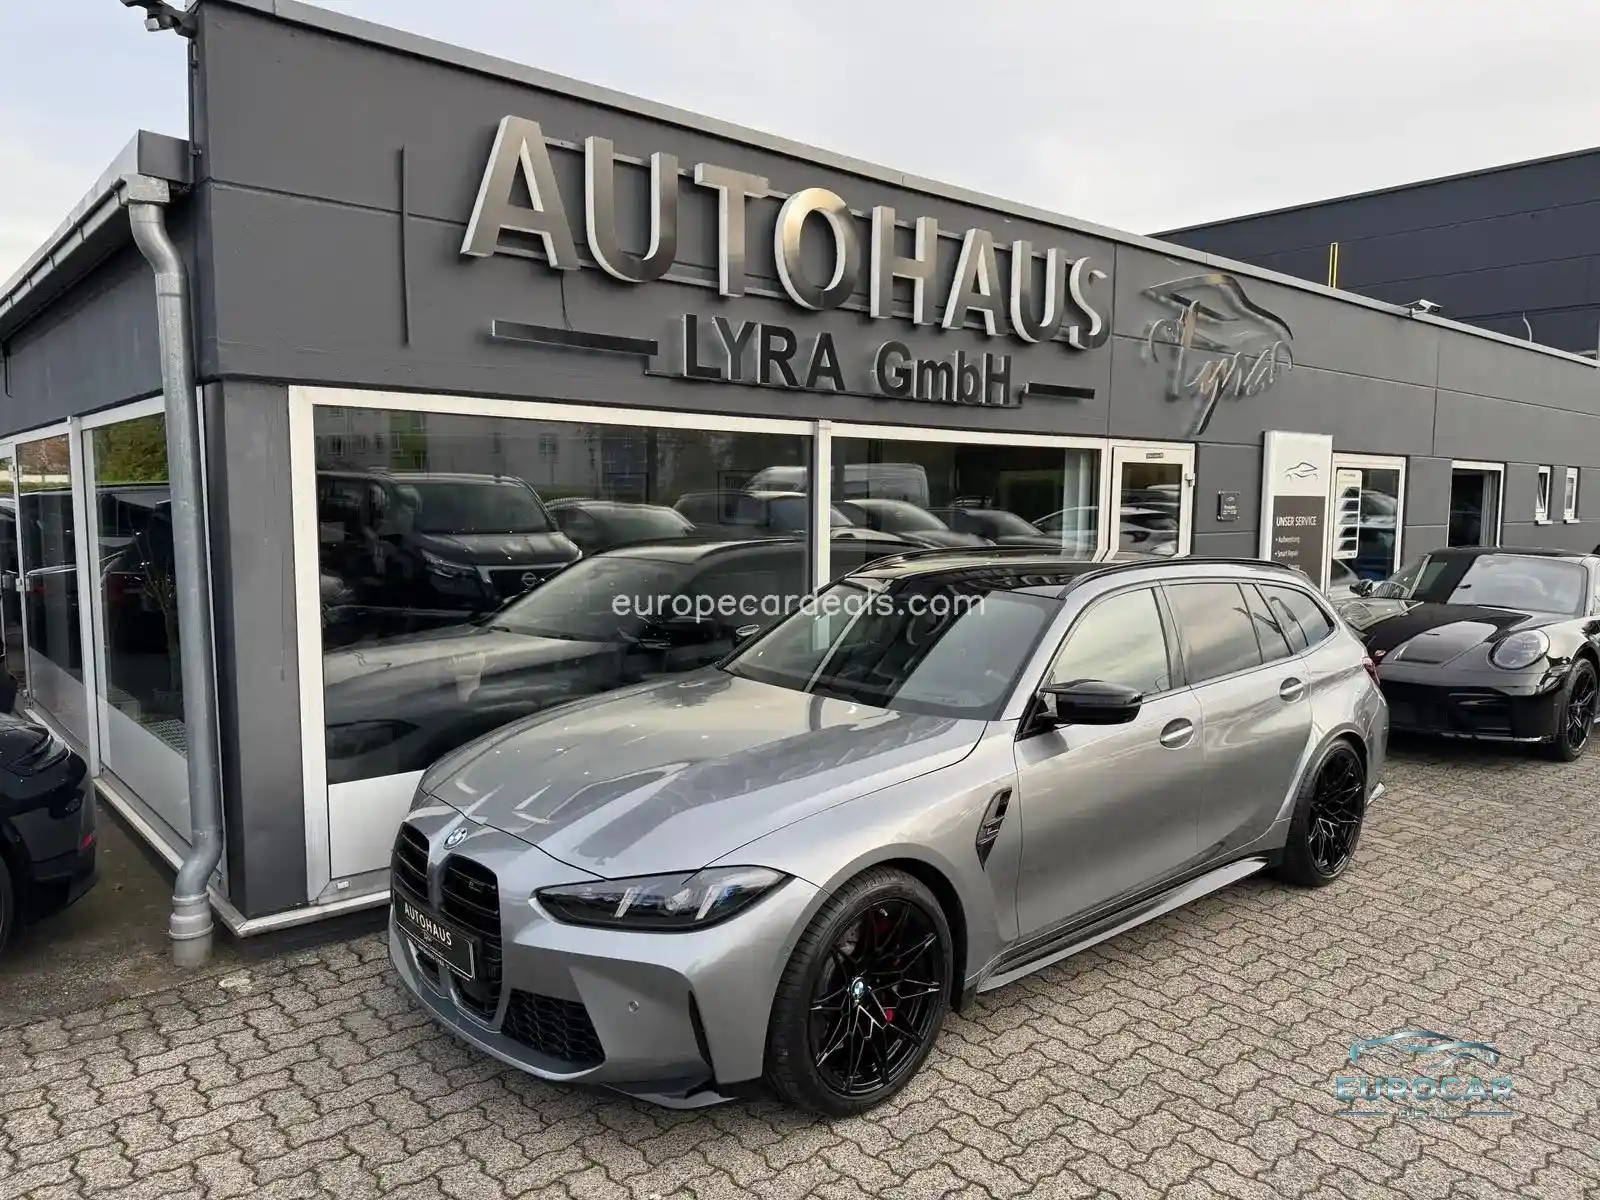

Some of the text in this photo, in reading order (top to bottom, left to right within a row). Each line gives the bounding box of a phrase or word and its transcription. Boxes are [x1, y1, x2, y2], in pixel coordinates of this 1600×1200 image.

[460, 115, 1111, 350] AUTOHAUS
[682, 313, 1011, 404] LYRA GmbH
[1276, 516, 1317, 527] UNSER SERVICE
[404, 902, 452, 946] AUTOHAUS
